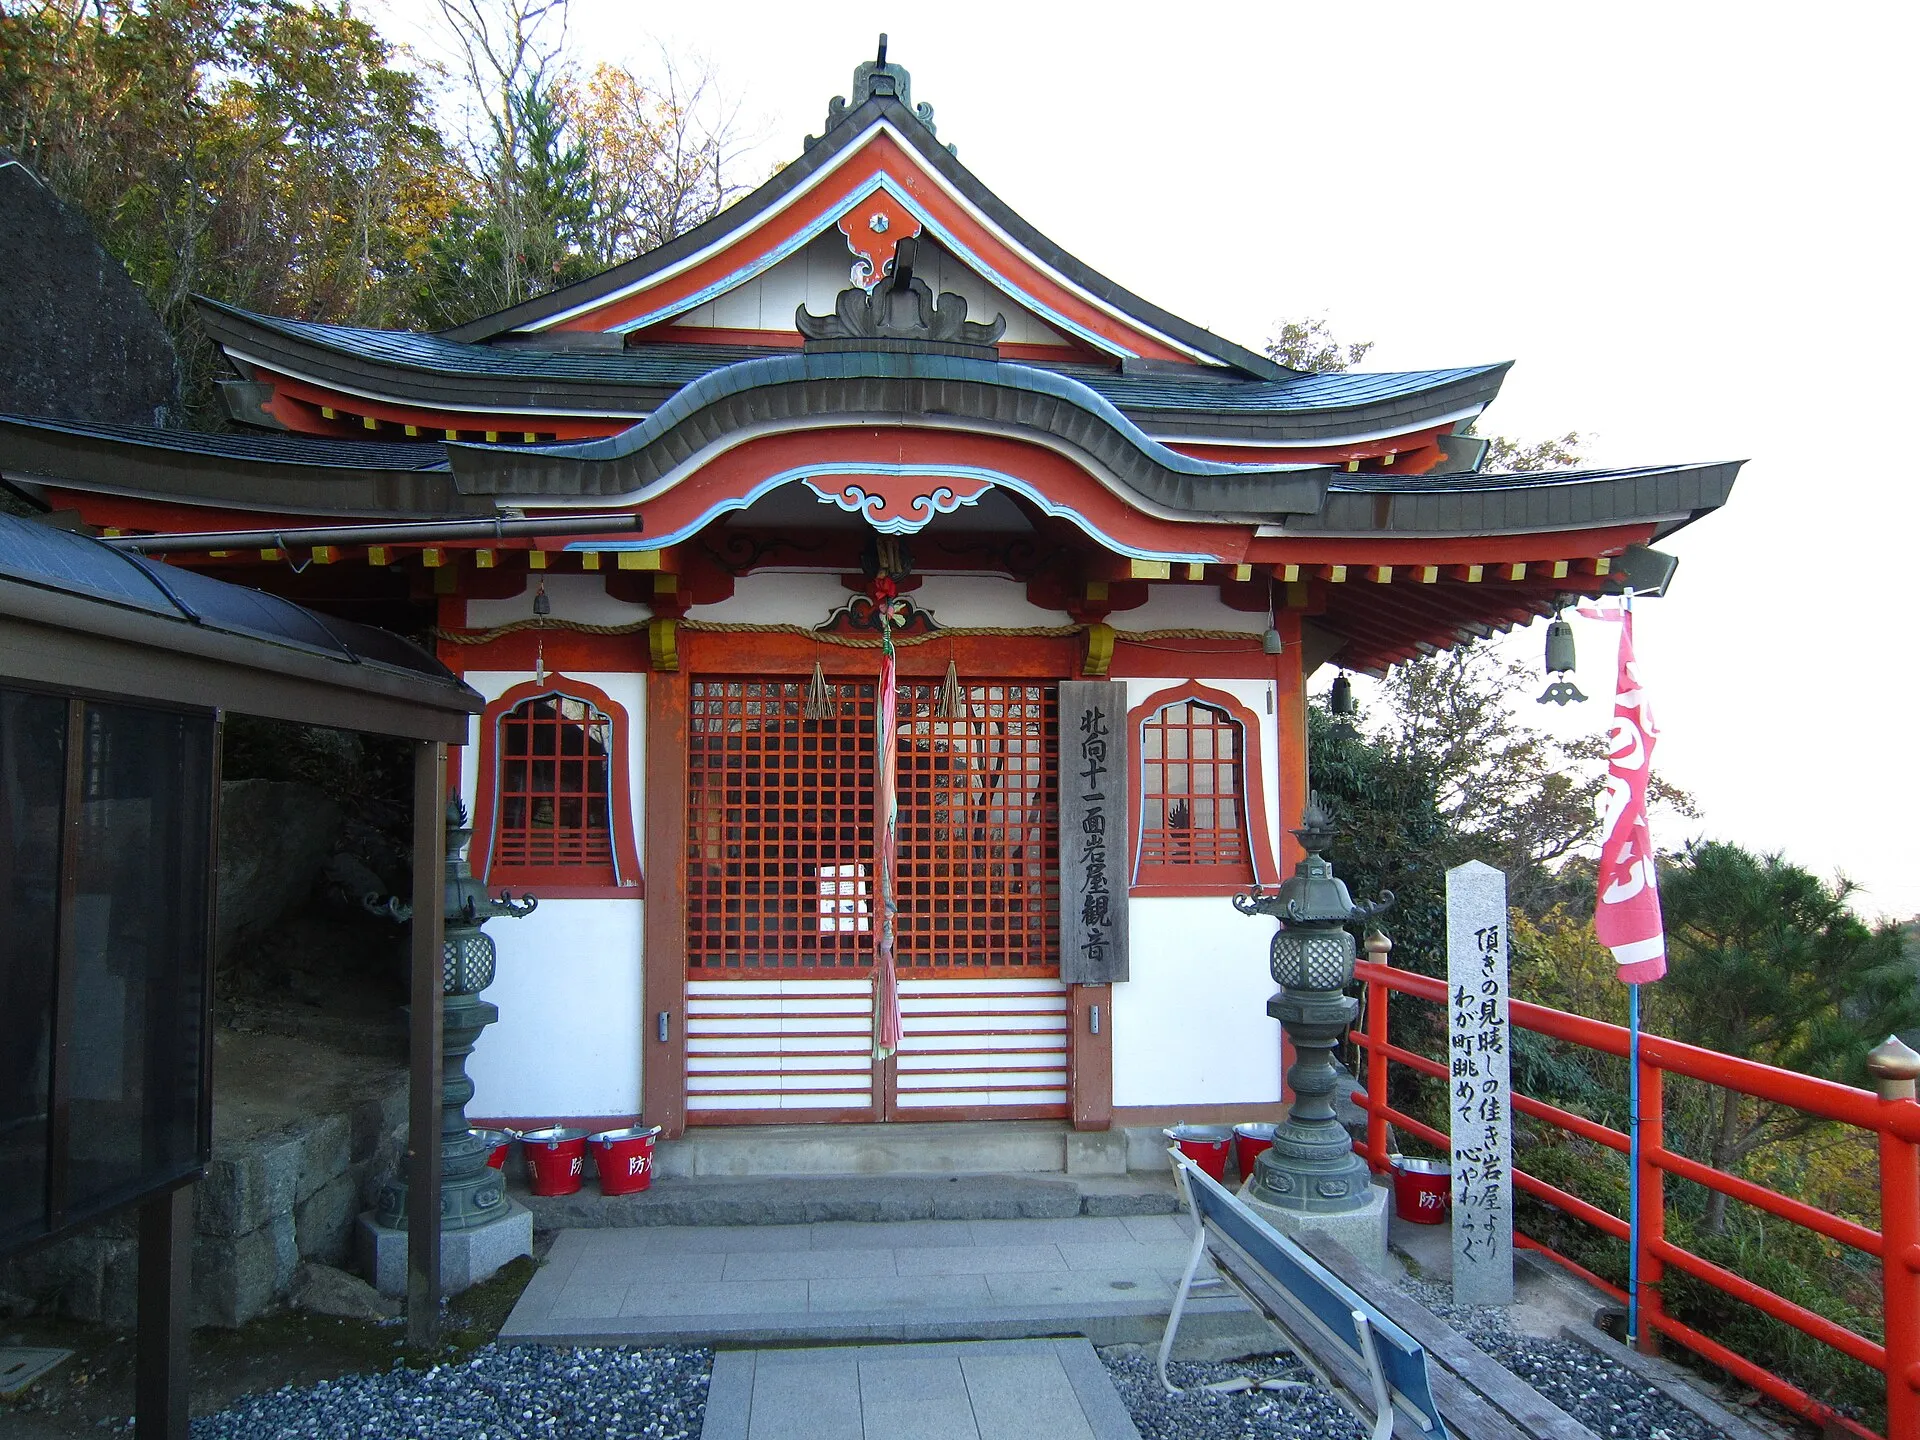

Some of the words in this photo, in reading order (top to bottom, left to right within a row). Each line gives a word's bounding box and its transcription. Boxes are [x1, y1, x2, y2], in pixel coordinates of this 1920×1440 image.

[1079, 705, 1112, 961] 北向十一面岩屋観音
